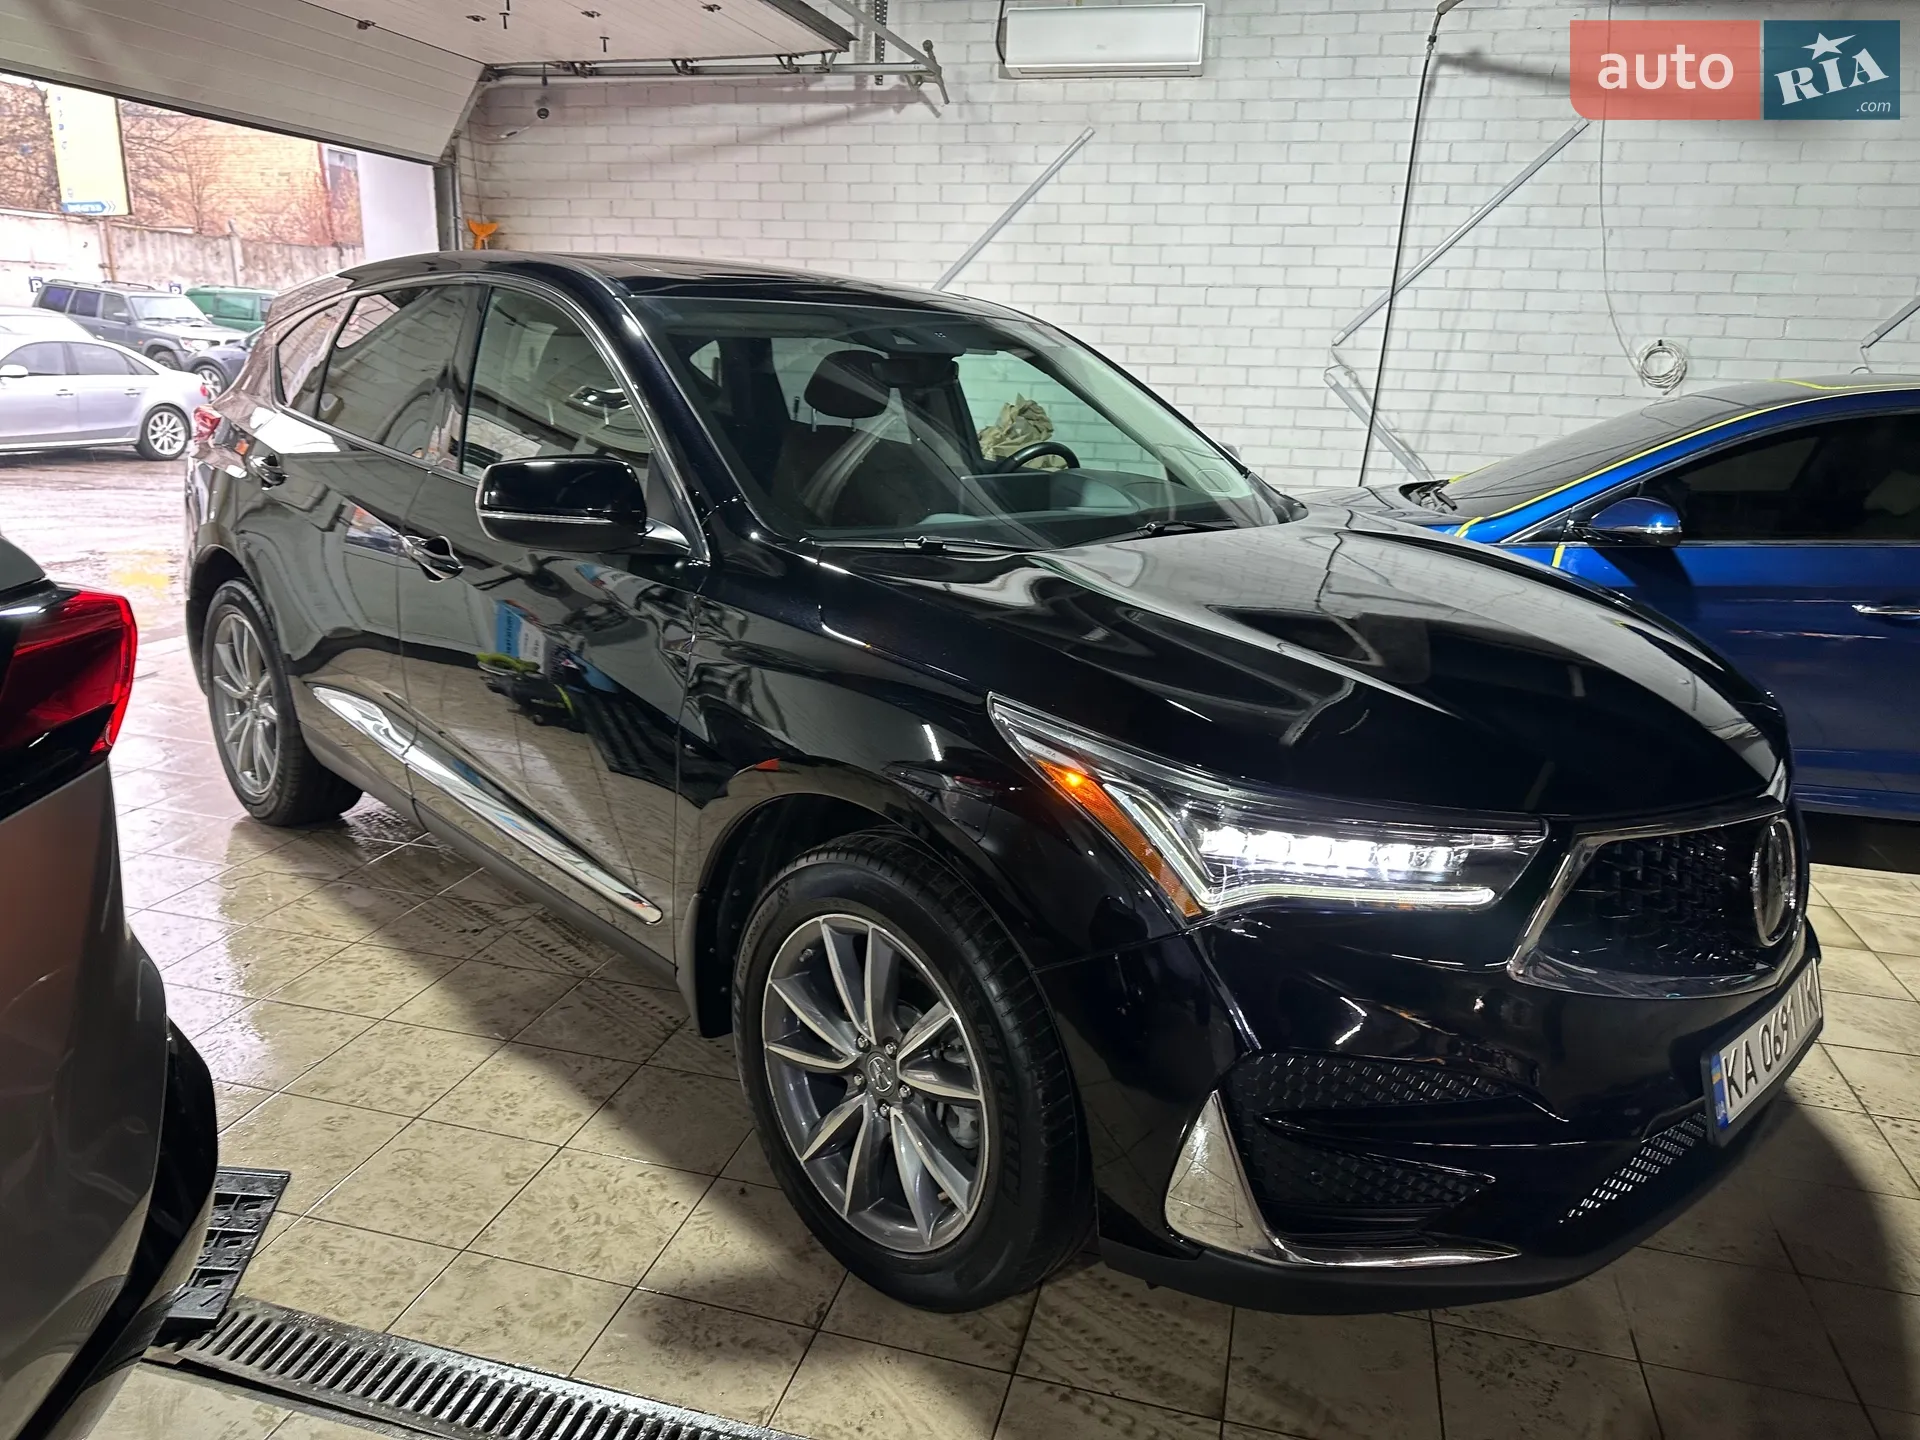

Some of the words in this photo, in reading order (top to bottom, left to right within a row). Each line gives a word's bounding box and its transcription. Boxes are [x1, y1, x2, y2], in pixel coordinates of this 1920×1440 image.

[1722, 1039, 1758, 1108] KA
[1758, 994, 1797, 1072] 0691
[1797, 968, 1819, 1028] IK
